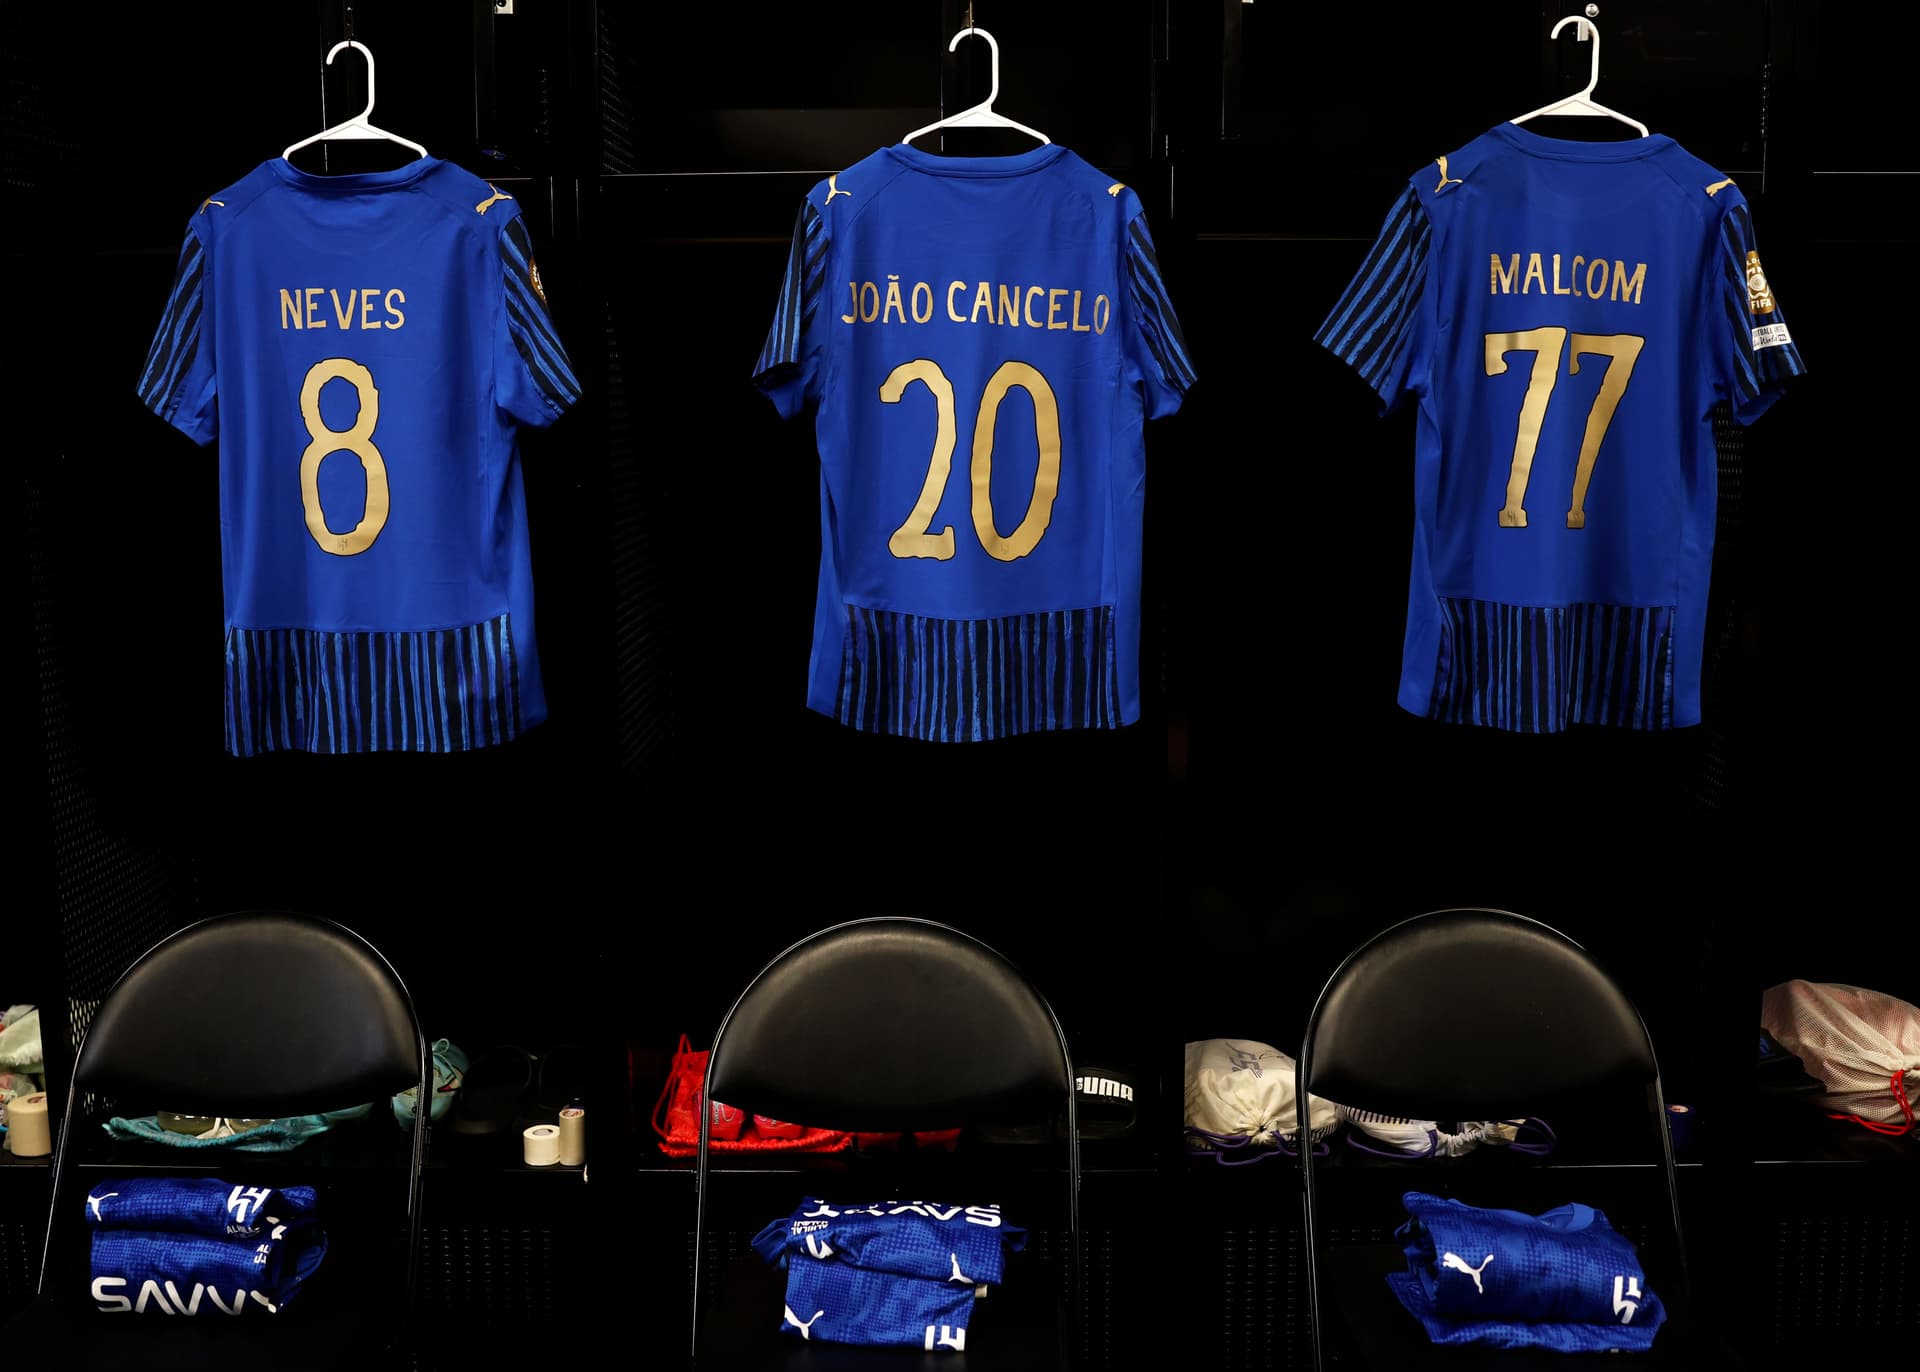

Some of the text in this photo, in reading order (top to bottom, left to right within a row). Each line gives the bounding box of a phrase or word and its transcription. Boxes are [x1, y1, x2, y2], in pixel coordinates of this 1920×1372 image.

[279, 288, 406, 330] NEVES
[841, 274, 1110, 335] JOÃO CANCELO
[1490, 252, 1648, 305] MALCOM
[1751, 299, 1772, 309] FIFA
[299, 357, 391, 557] 8
[1484, 325, 1646, 529] 77
[878, 359, 1062, 562] 20
